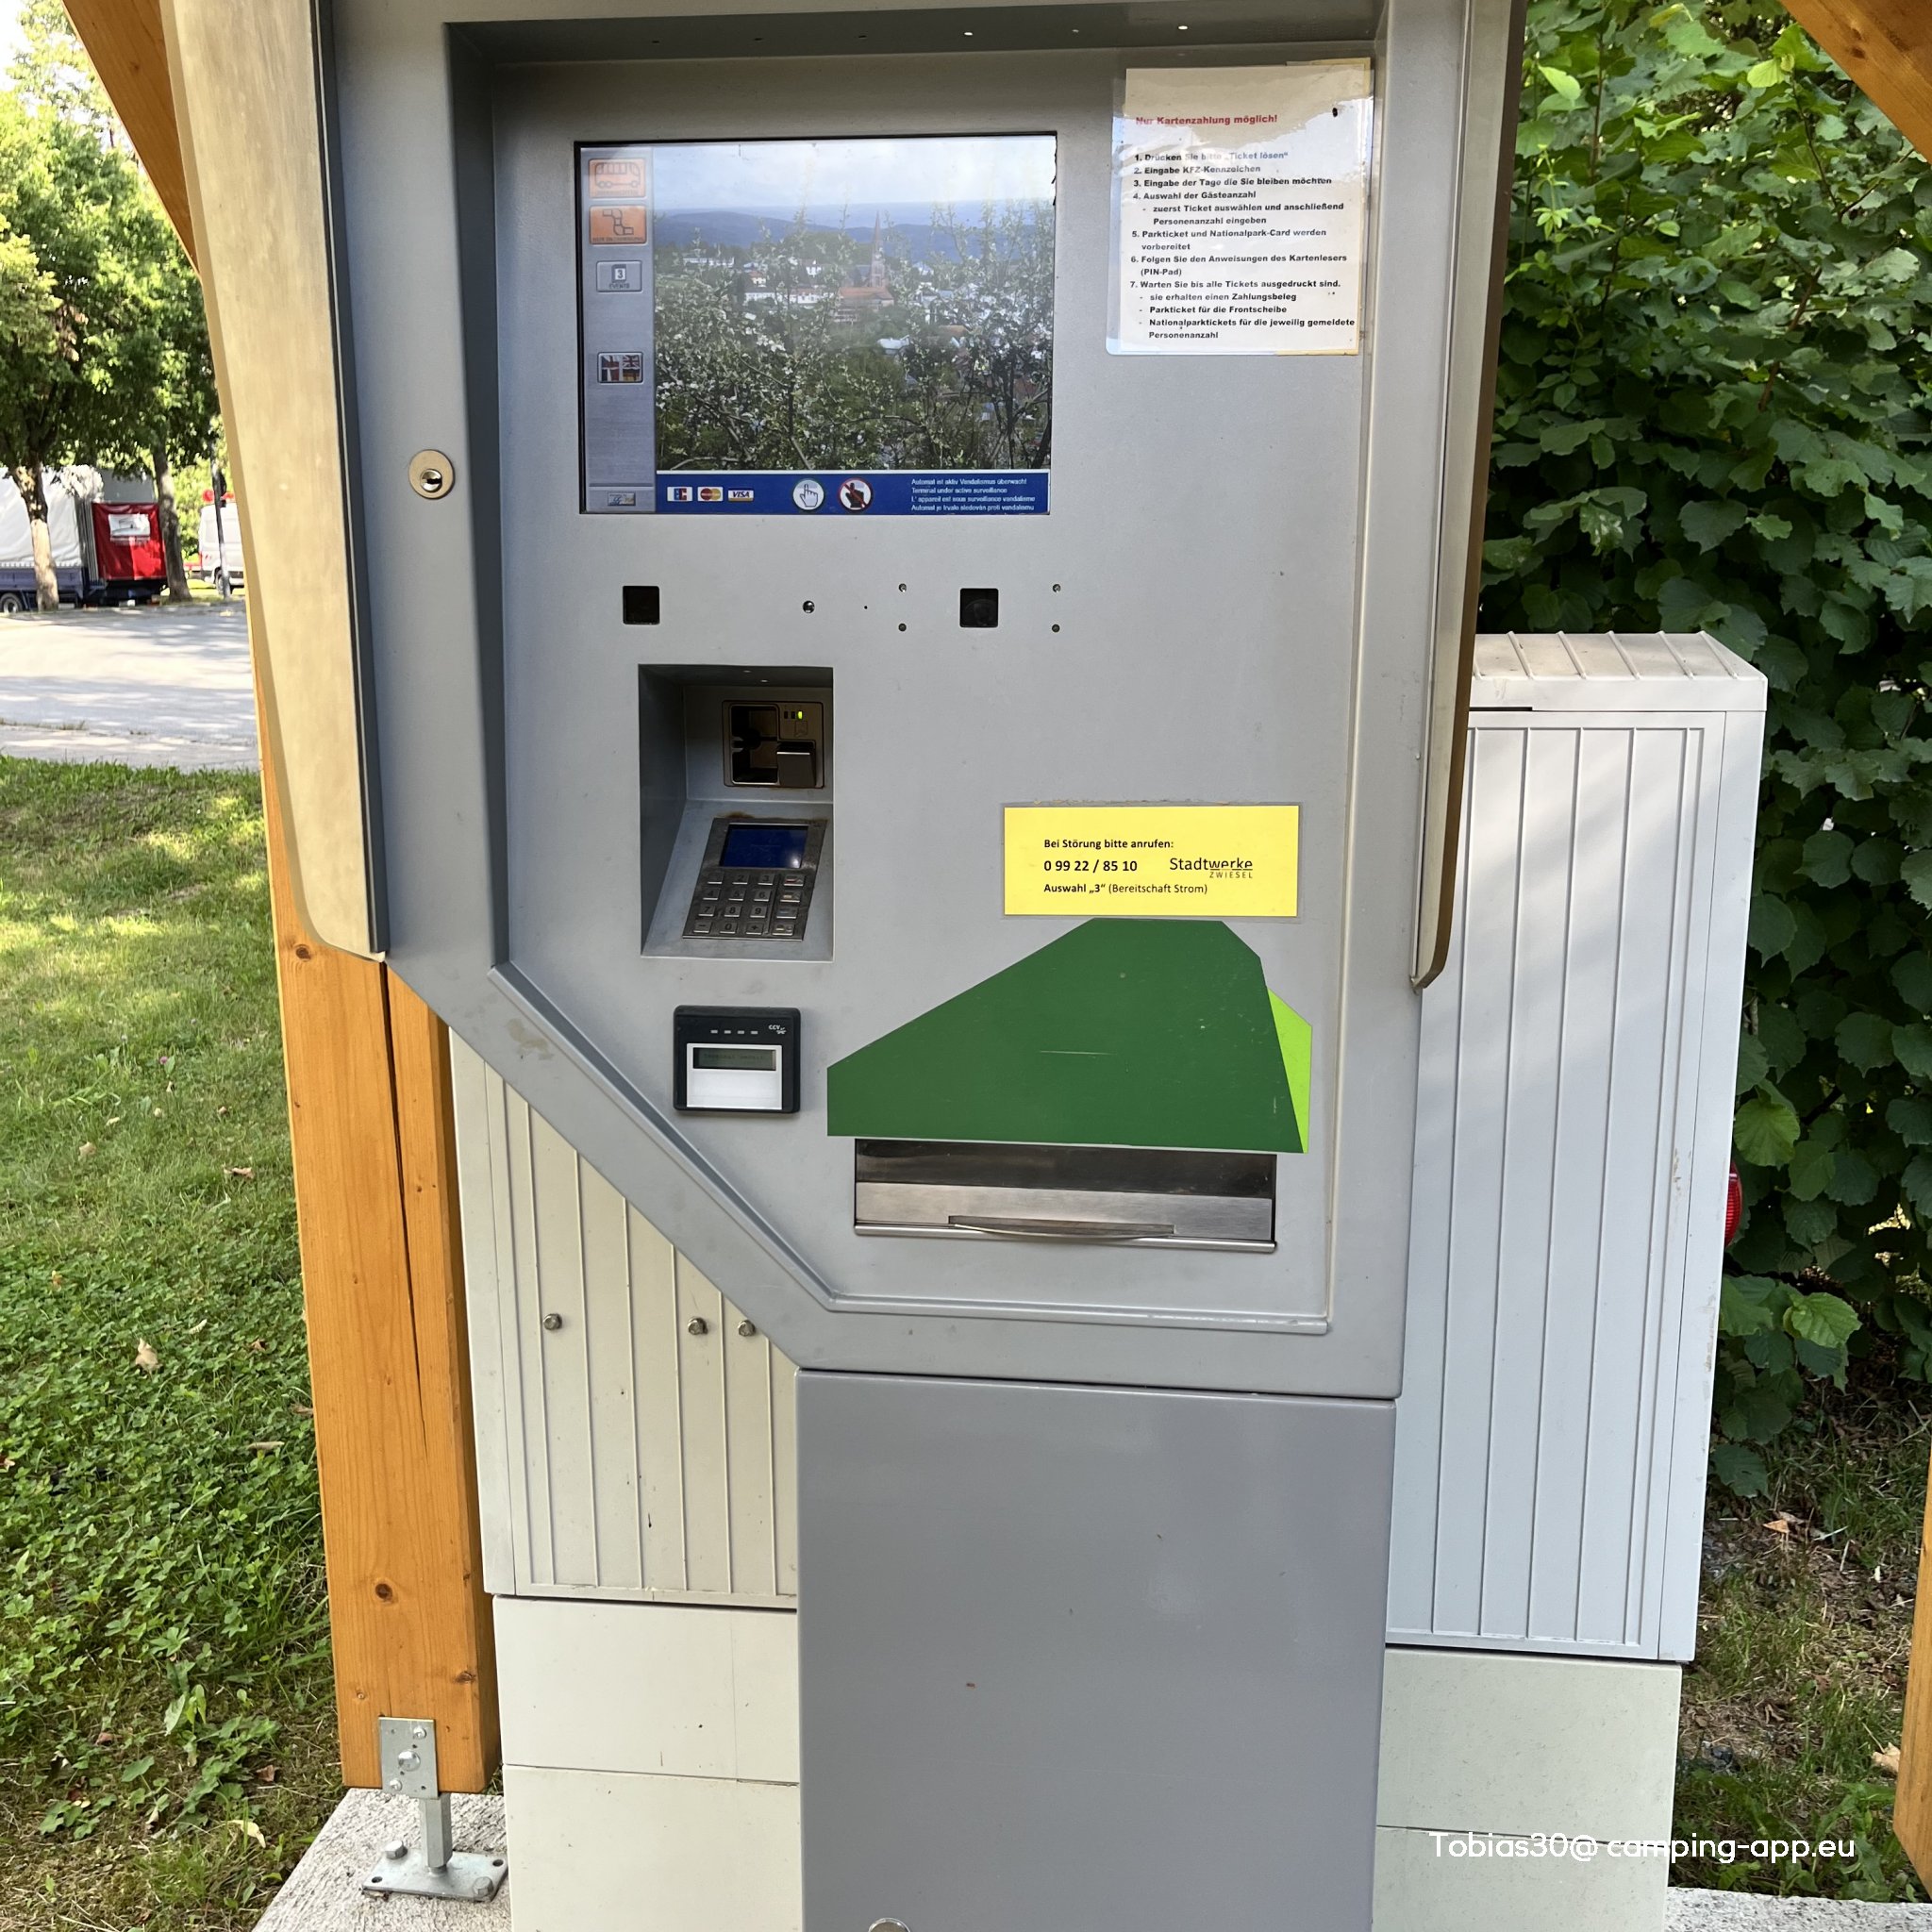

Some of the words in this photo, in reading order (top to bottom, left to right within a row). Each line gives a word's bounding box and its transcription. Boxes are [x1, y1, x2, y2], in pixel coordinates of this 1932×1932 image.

[1157, 116, 1230, 125] Kartenzahlung
[1234, 115, 1277, 125] möglich!
[1144, 167, 1179, 175] Eingabe
[1182, 165, 1260, 174] KFZ-Kennzeichen
[1144, 179, 1179, 188] Eingabe
[1291, 176, 1332, 185] möchten
[1153, 204, 1181, 212] zuerst
[1214, 203, 1262, 211] auswählen
[1153, 217, 1224, 225] Personenanzahl
[1226, 217, 1266, 225] eingeben
[1209, 229, 1291, 238] Nationalpark-Card
[1141, 255, 1171, 264] Folgen
[1208, 255, 1268, 263] Anweisungen
[1141, 268, 1182, 276] (PIN-Pad)
[1261, 280, 1317, 289] ausgedruckt
[1232, 293, 1297, 302] Zahlungsbeleg
[1149, 319, 1237, 327] Nationalparktickets
[1270, 319, 1305, 327] jeweilig
[1307, 319, 1355, 327] gemeldete
[1044, 840, 1059, 848] Bei
[1062, 839, 1101, 850] Störung
[1104, 840, 1127, 848] bitte
[1131, 839, 1174, 848] anrufen:
[1044, 861, 1052, 871] 0
[1056, 861, 1071, 871] 99
[1074, 861, 1090, 871] 22
[1093, 859, 1099, 874] /
[1103, 861, 1118, 871] 85
[1123, 861, 1138, 871] 10
[1170, 858, 1253, 870] Stadtwerke
[1044, 884, 1087, 892] Auswahl
[1108, 884, 1171, 893] (Bereitschaft
[1174, 884, 1208, 893] Strom)
